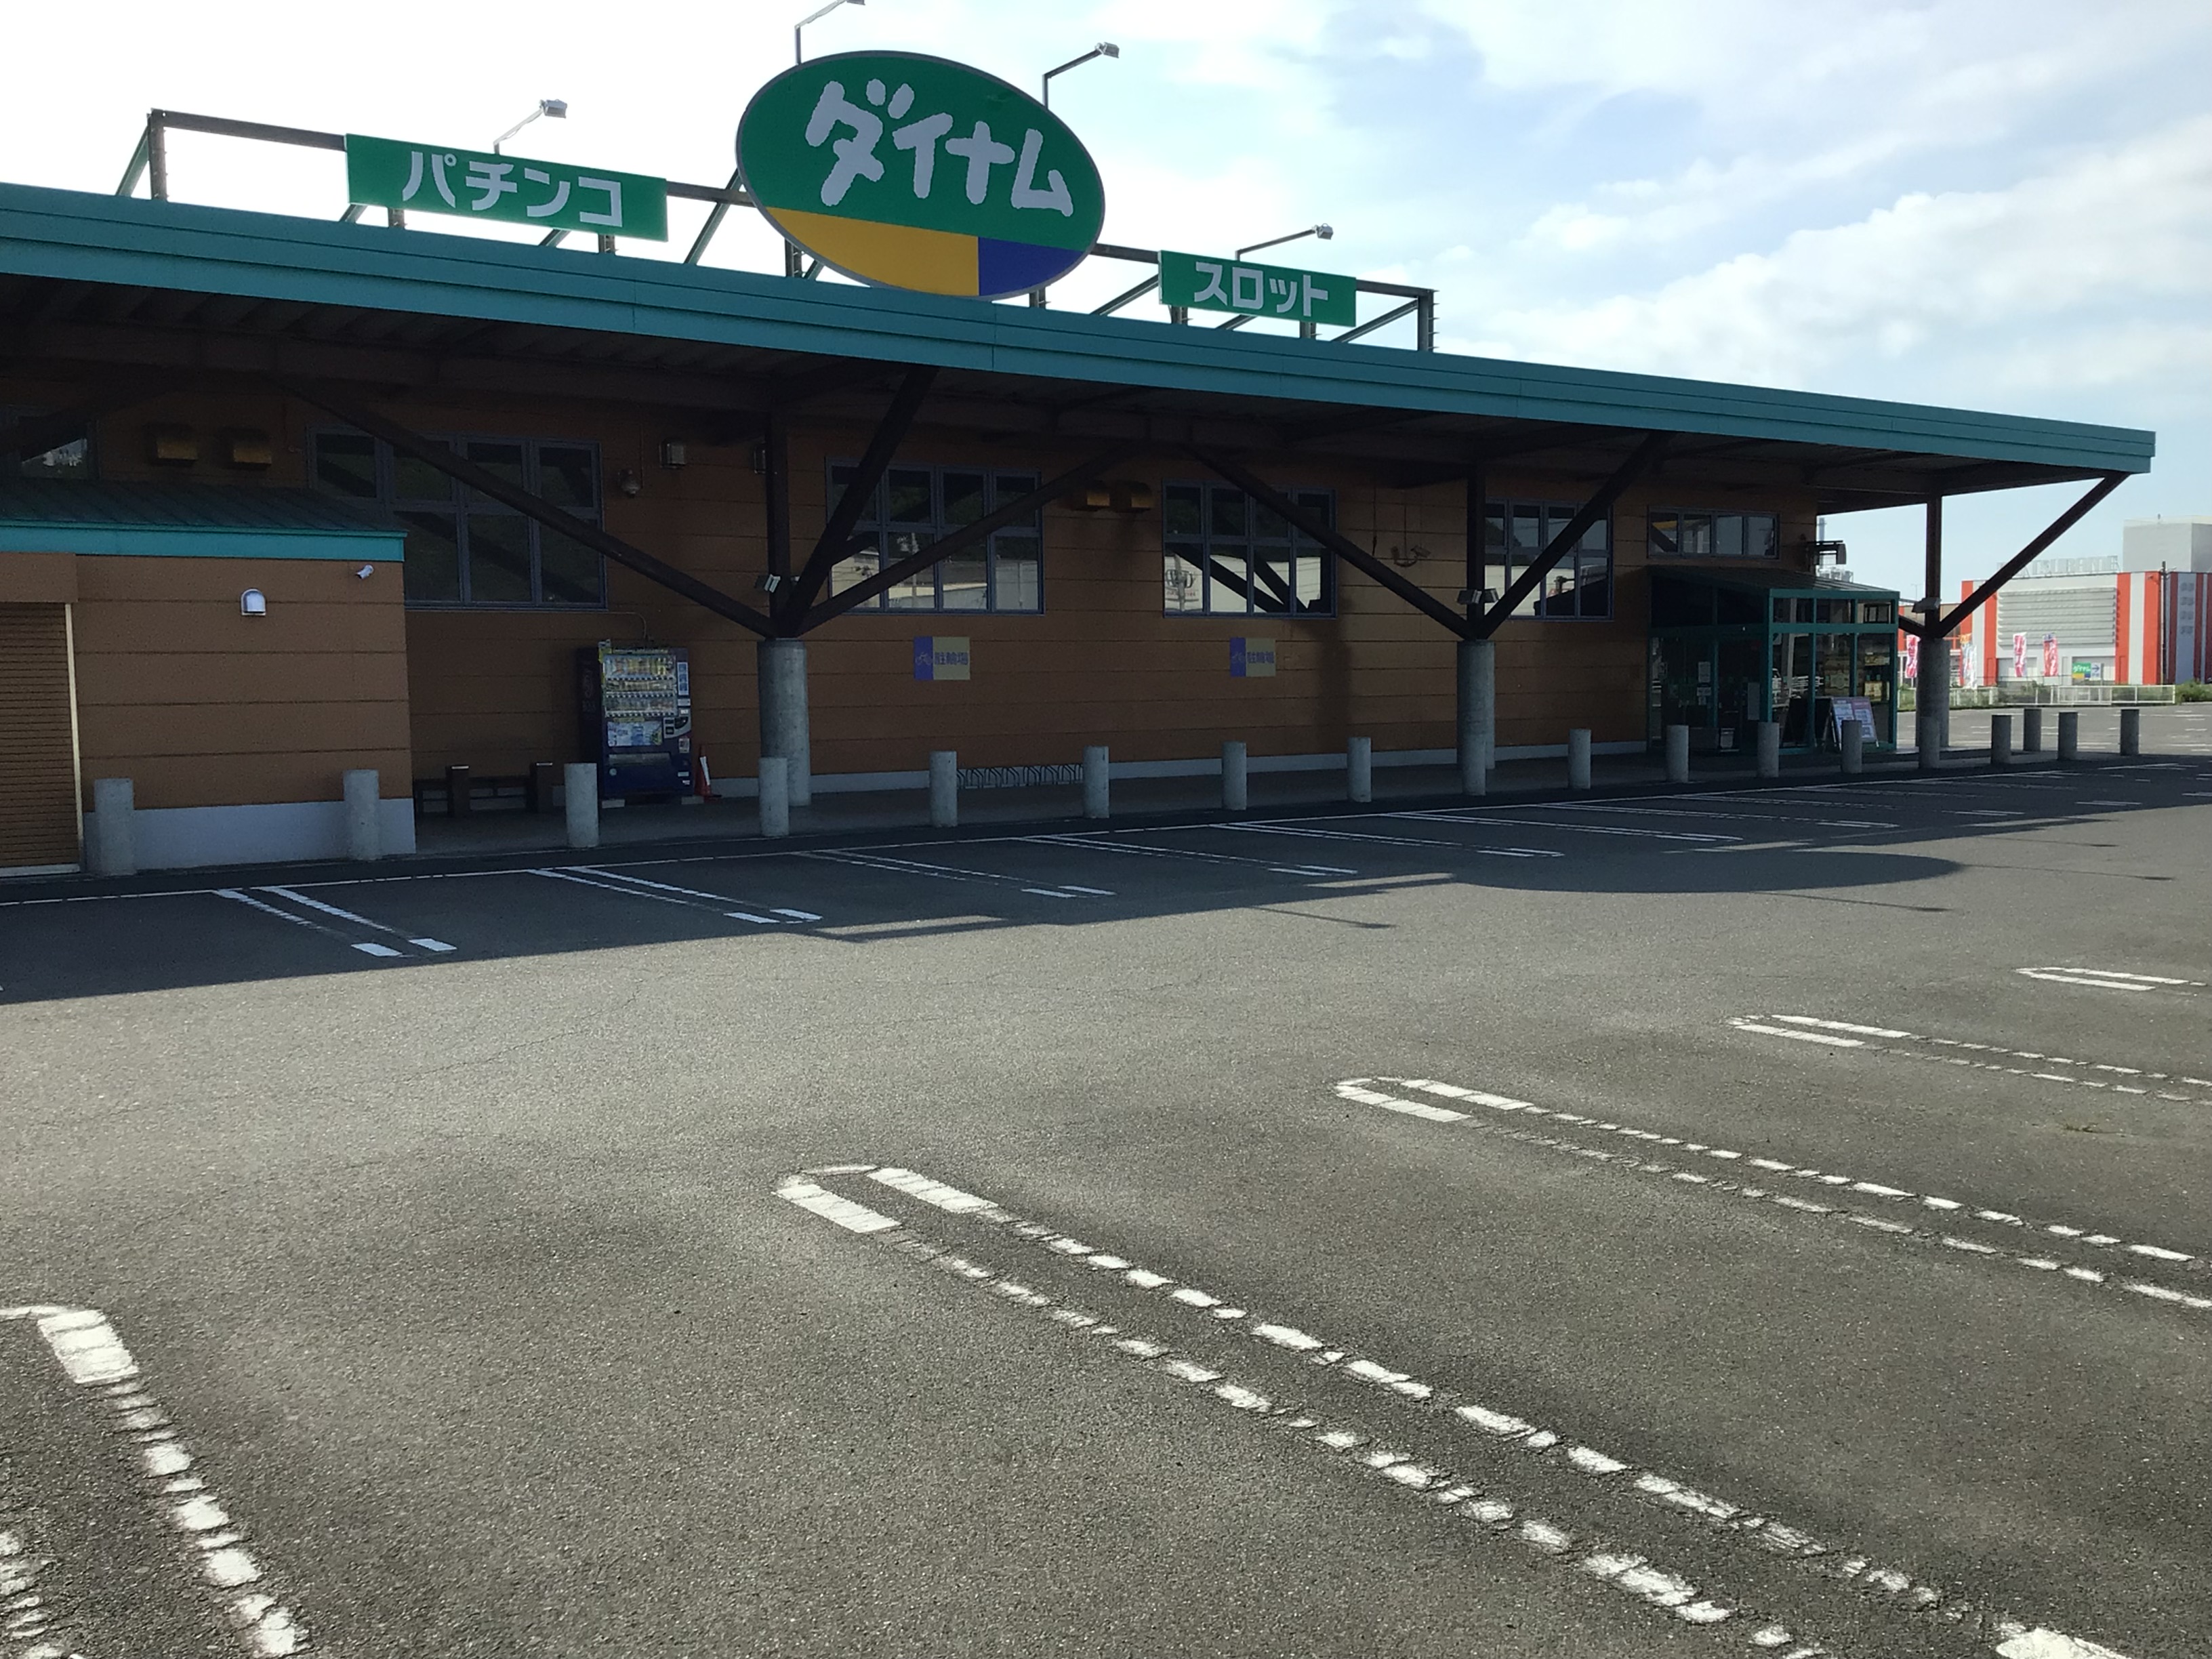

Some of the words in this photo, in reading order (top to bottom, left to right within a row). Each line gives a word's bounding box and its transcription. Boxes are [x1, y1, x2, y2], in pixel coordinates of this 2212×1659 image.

[805, 79, 1074, 217] ダイナム
[403, 150, 623, 227] パチンコ
[1194, 261, 1328, 317] スロット
